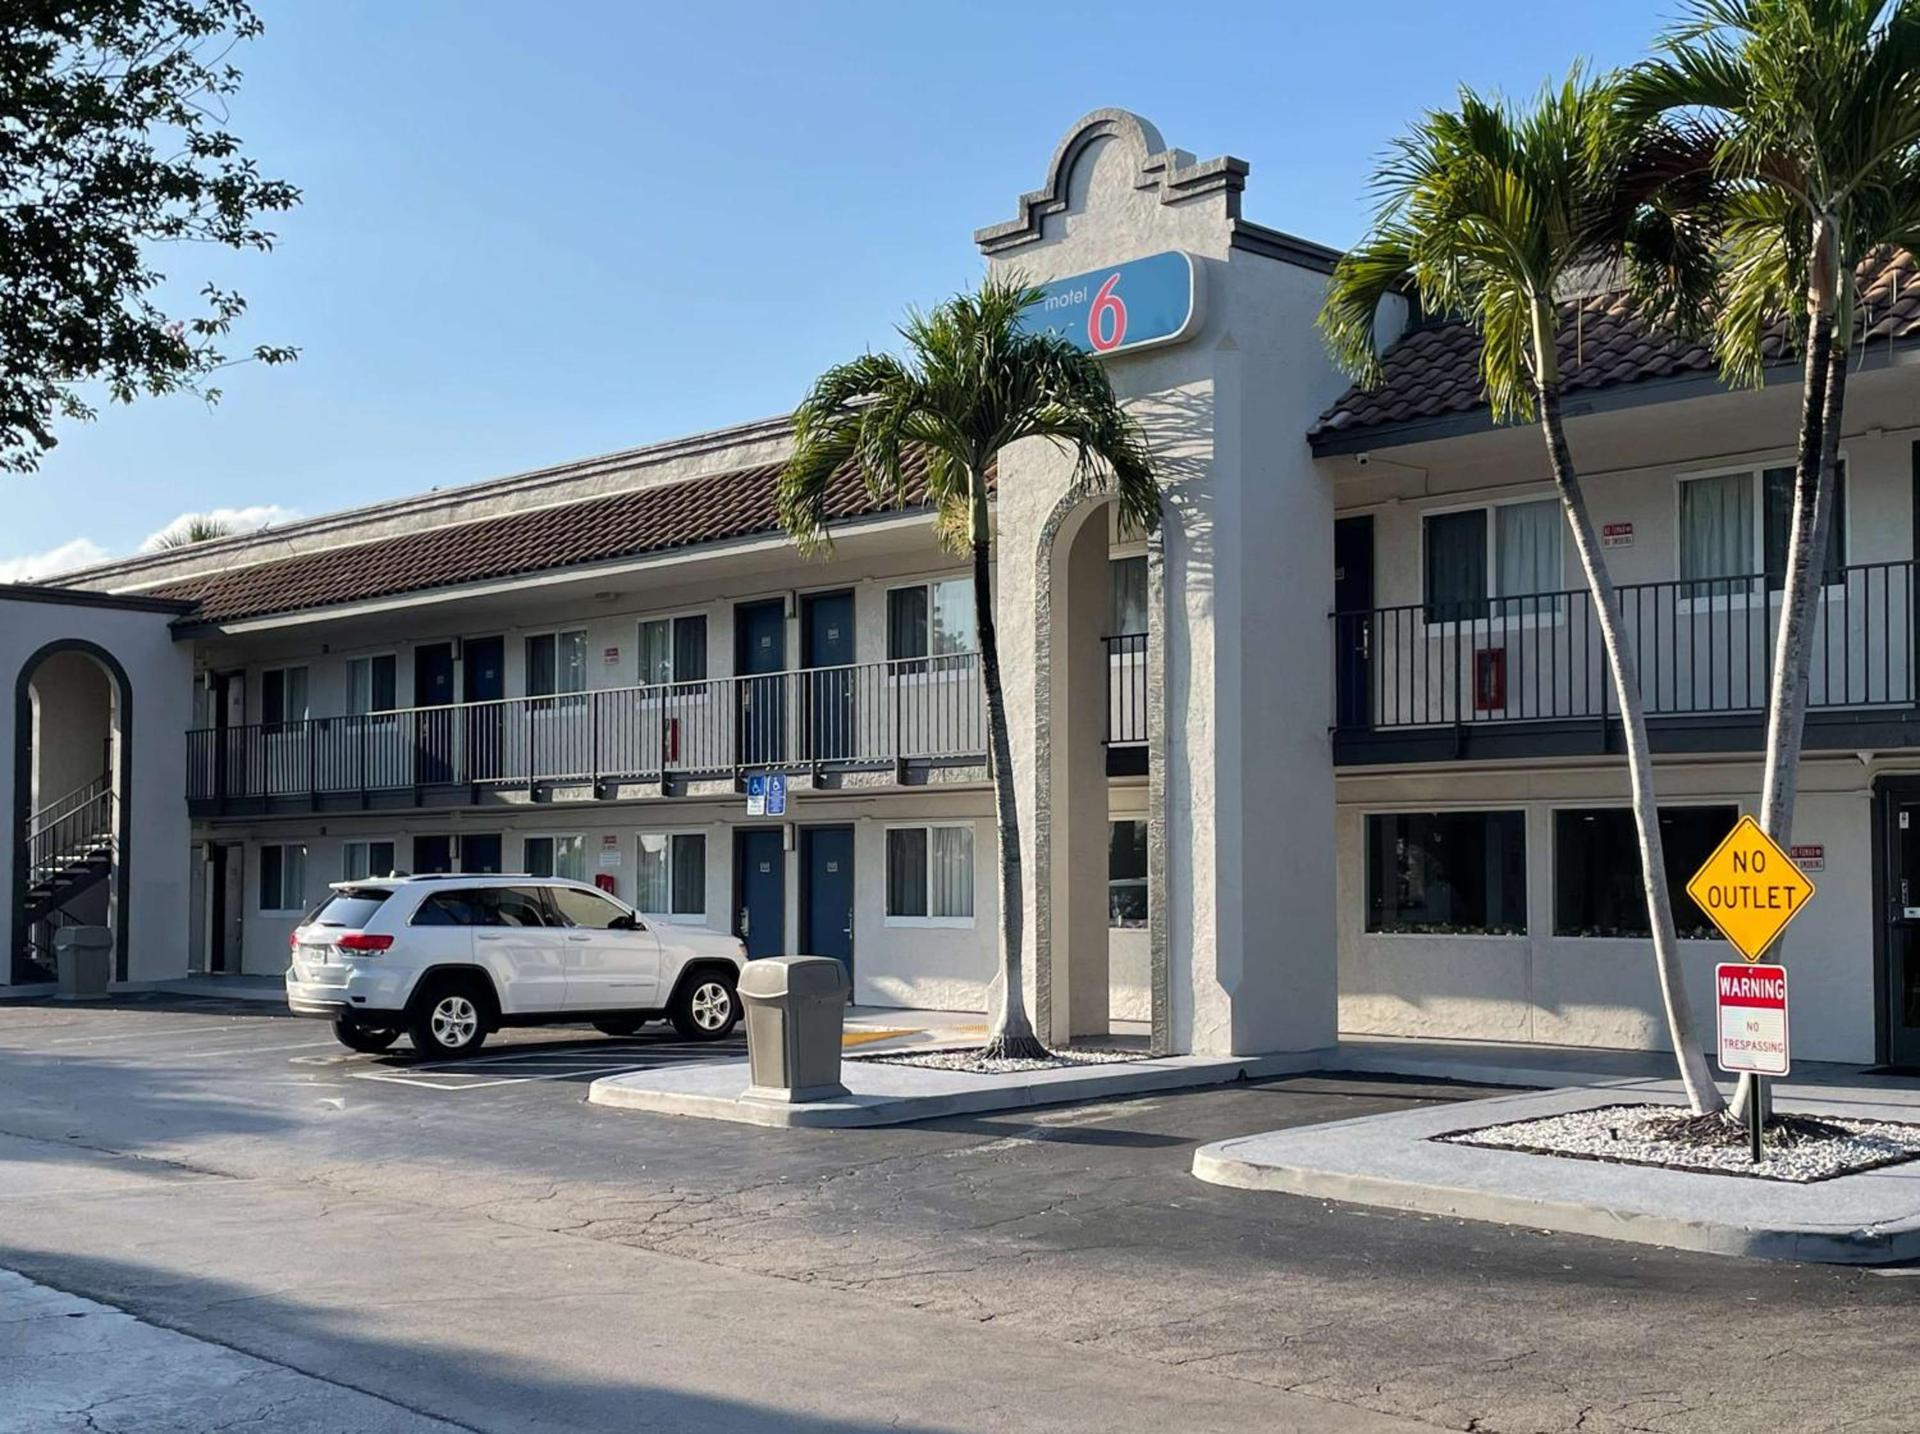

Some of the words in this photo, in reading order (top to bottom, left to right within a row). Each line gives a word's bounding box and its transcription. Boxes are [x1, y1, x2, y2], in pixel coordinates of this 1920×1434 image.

[1045, 286, 1087, 312] motel
[1088, 272, 1128, 352] 6
[1733, 850, 1766, 873] NO
[1707, 885, 1796, 909] OUTLET
[1720, 976, 1785, 1000] WARNING
[1746, 1021, 1760, 1033] NO
[1724, 1038, 1785, 1054] TRESPASSING
